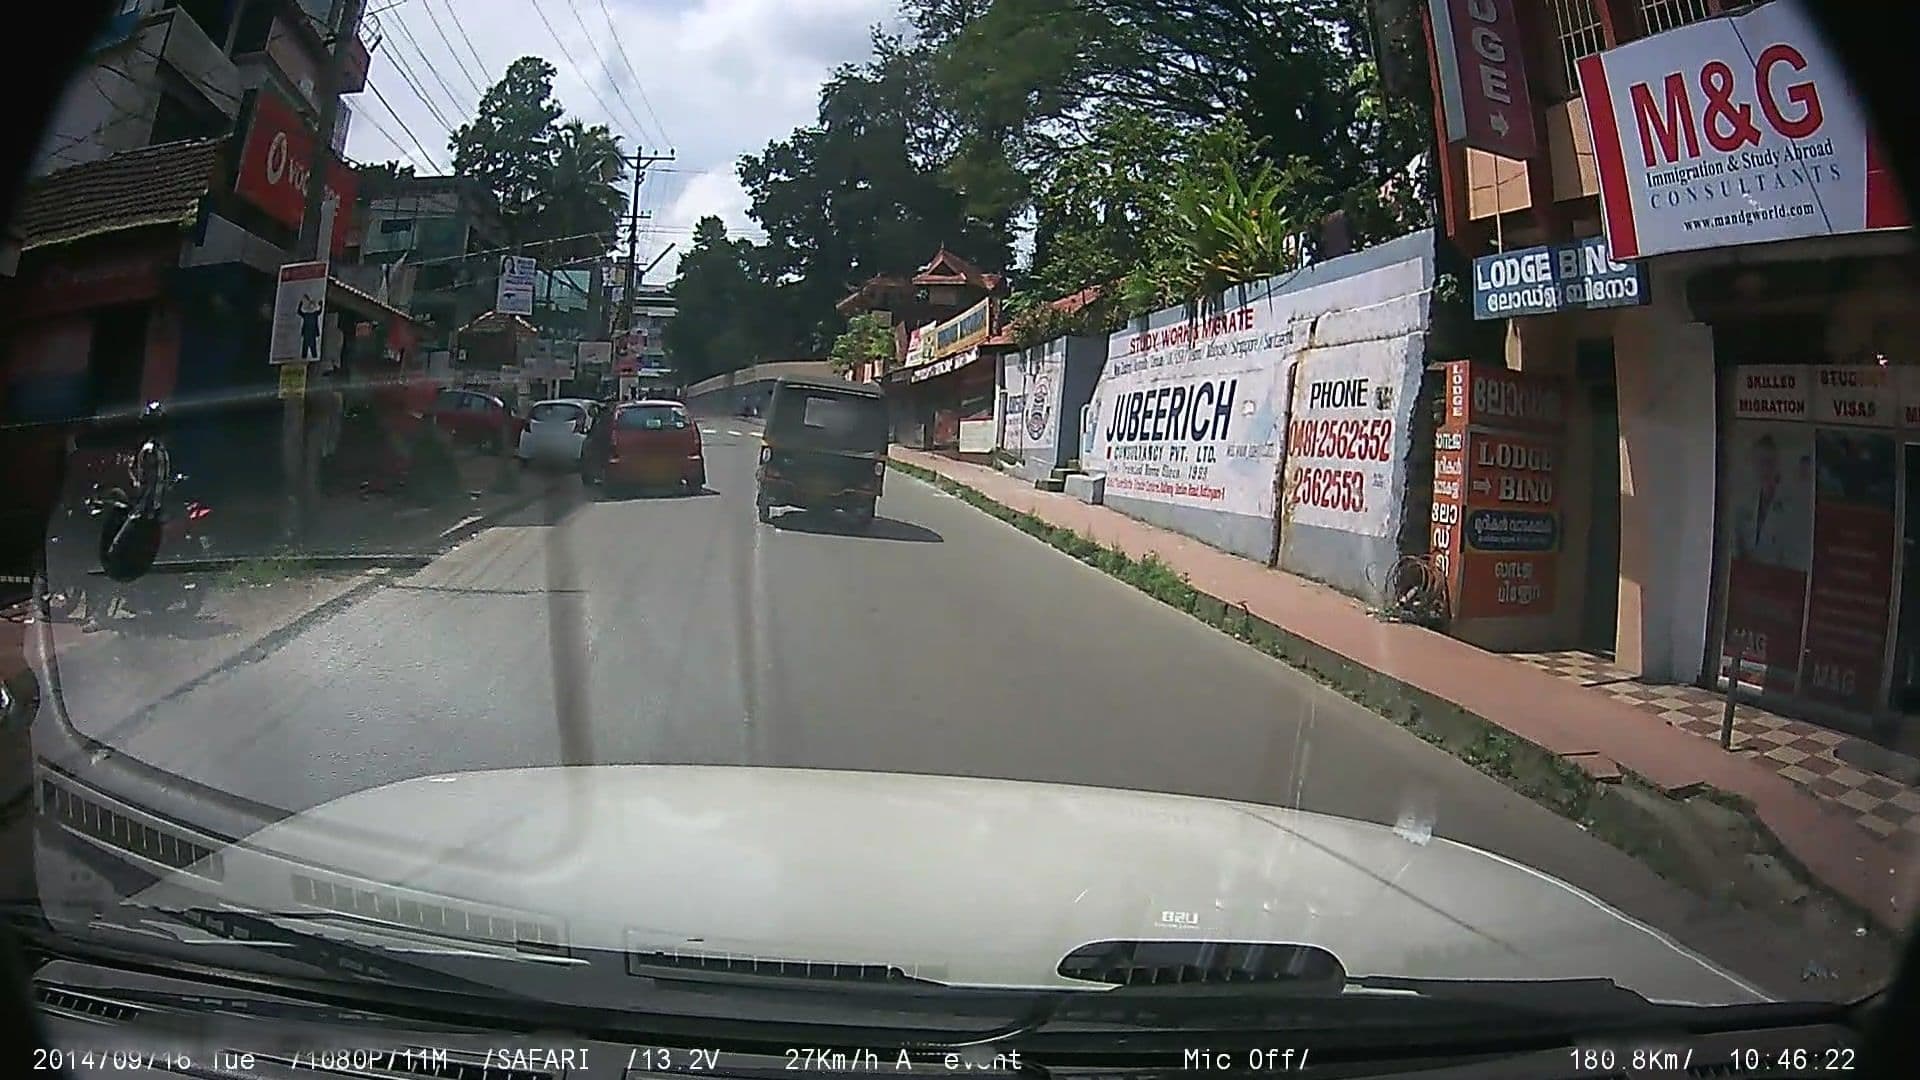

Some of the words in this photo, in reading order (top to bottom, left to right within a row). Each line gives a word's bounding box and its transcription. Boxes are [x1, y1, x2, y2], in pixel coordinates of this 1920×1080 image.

[1629, 43, 1824, 168] M&G
[1647, 160, 1723, 188] Immigration
[1727, 155, 1740, 172] &
[1742, 150, 1781, 170] Study
[1784, 138, 1834, 164] Abroad
[1651, 163, 1841, 210] CONSULTANTS
[1684, 202, 1815, 232] www.mandgworld.com
[1476, 252, 1552, 291] LODGE
[1202, 308, 1254, 338] MIGRATE
[1309, 379, 1369, 409] PHONE
[1451, 364, 1463, 417] LODGE
[1746, 375, 1796, 390] SKILLED
[1106, 379, 1237, 442] JUBEERICH
[1738, 398, 1805, 414] MIGRATION
[1833, 400, 1876, 416] VISAS
[1169, 446, 1189, 462] PVT.
[1478, 441, 1554, 472] LODGE
[1498, 476, 1554, 503] BINO
